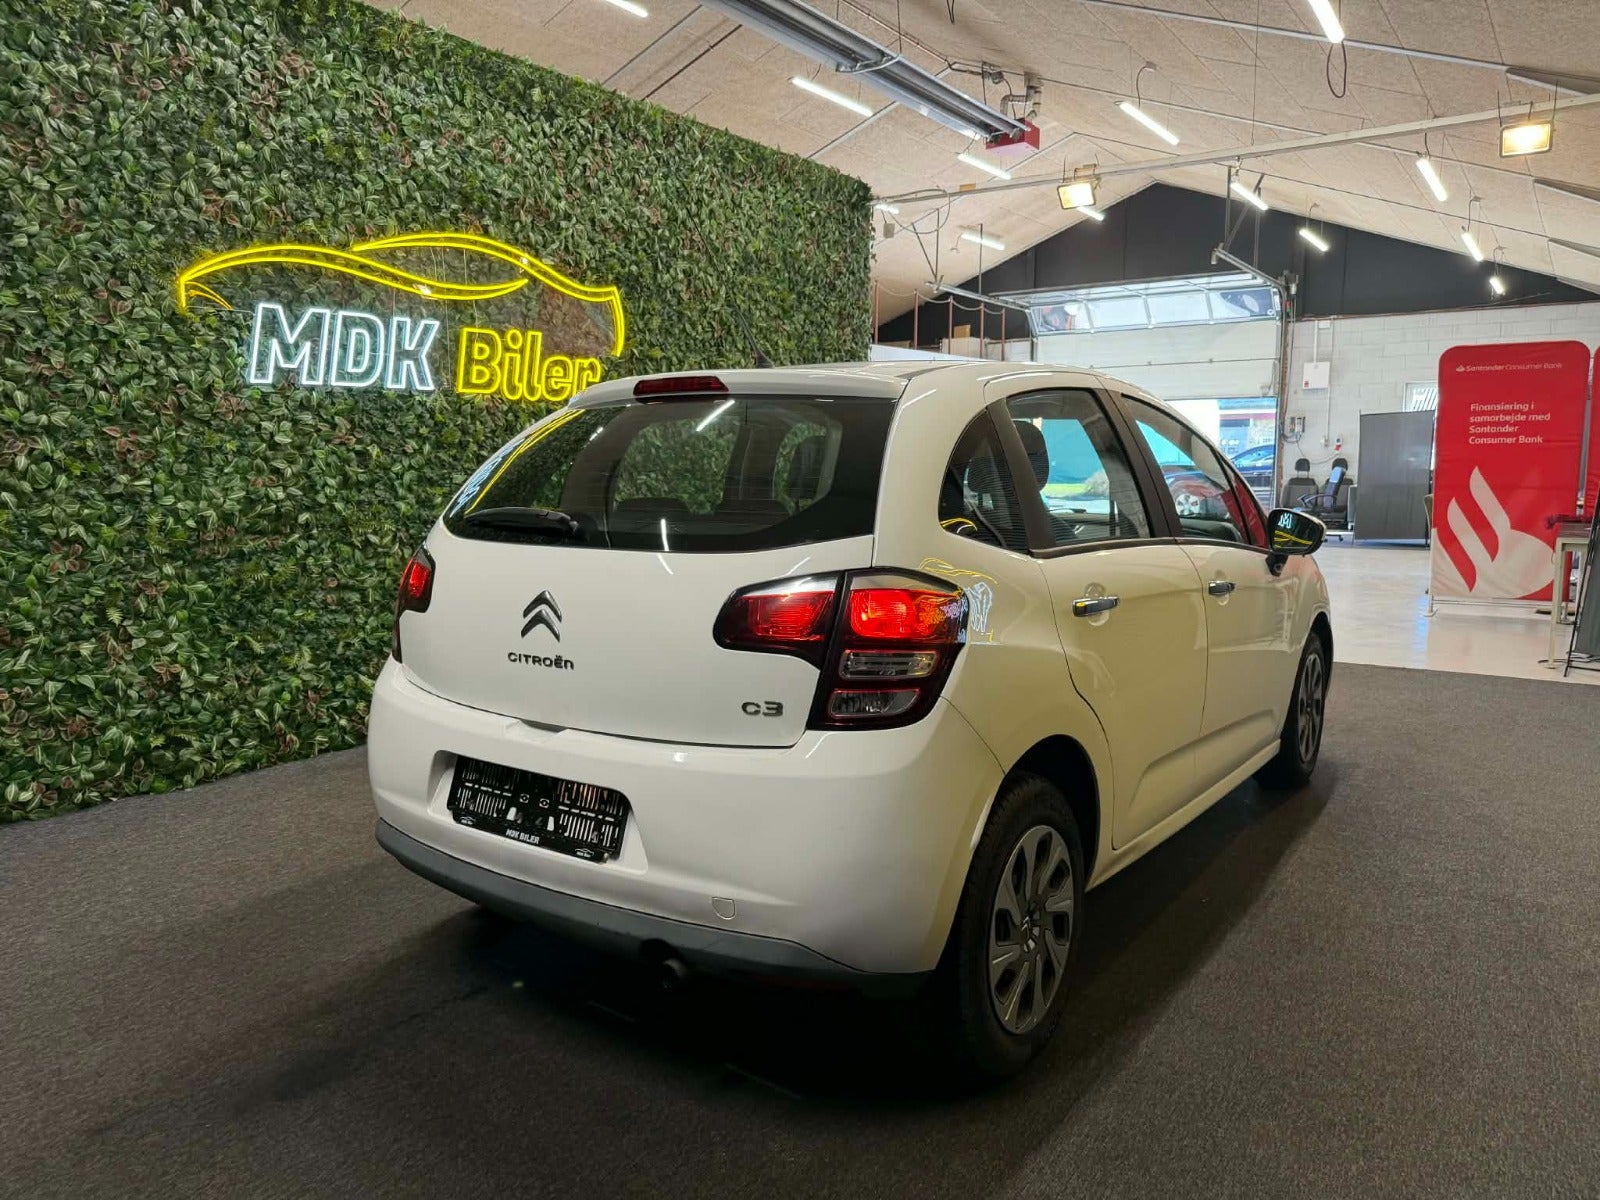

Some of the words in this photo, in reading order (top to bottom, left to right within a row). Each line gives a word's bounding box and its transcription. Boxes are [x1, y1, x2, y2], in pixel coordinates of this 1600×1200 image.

[249, 302, 440, 391] MDK
[456, 327, 603, 402] Biler
[1466, 364, 1504, 372] Santander
[1505, 362, 1542, 371] Consumer
[1543, 361, 1563, 369] Bank
[1470, 402, 1529, 412] Finansiering
[1469, 413, 1527, 424] samarbejde
[1528, 412, 1551, 421] med
[1469, 424, 1519, 433] Santander
[1468, 436, 1517, 445] Consumer
[1518, 435, 1544, 444] Bank
[741, 701, 783, 717] C3
